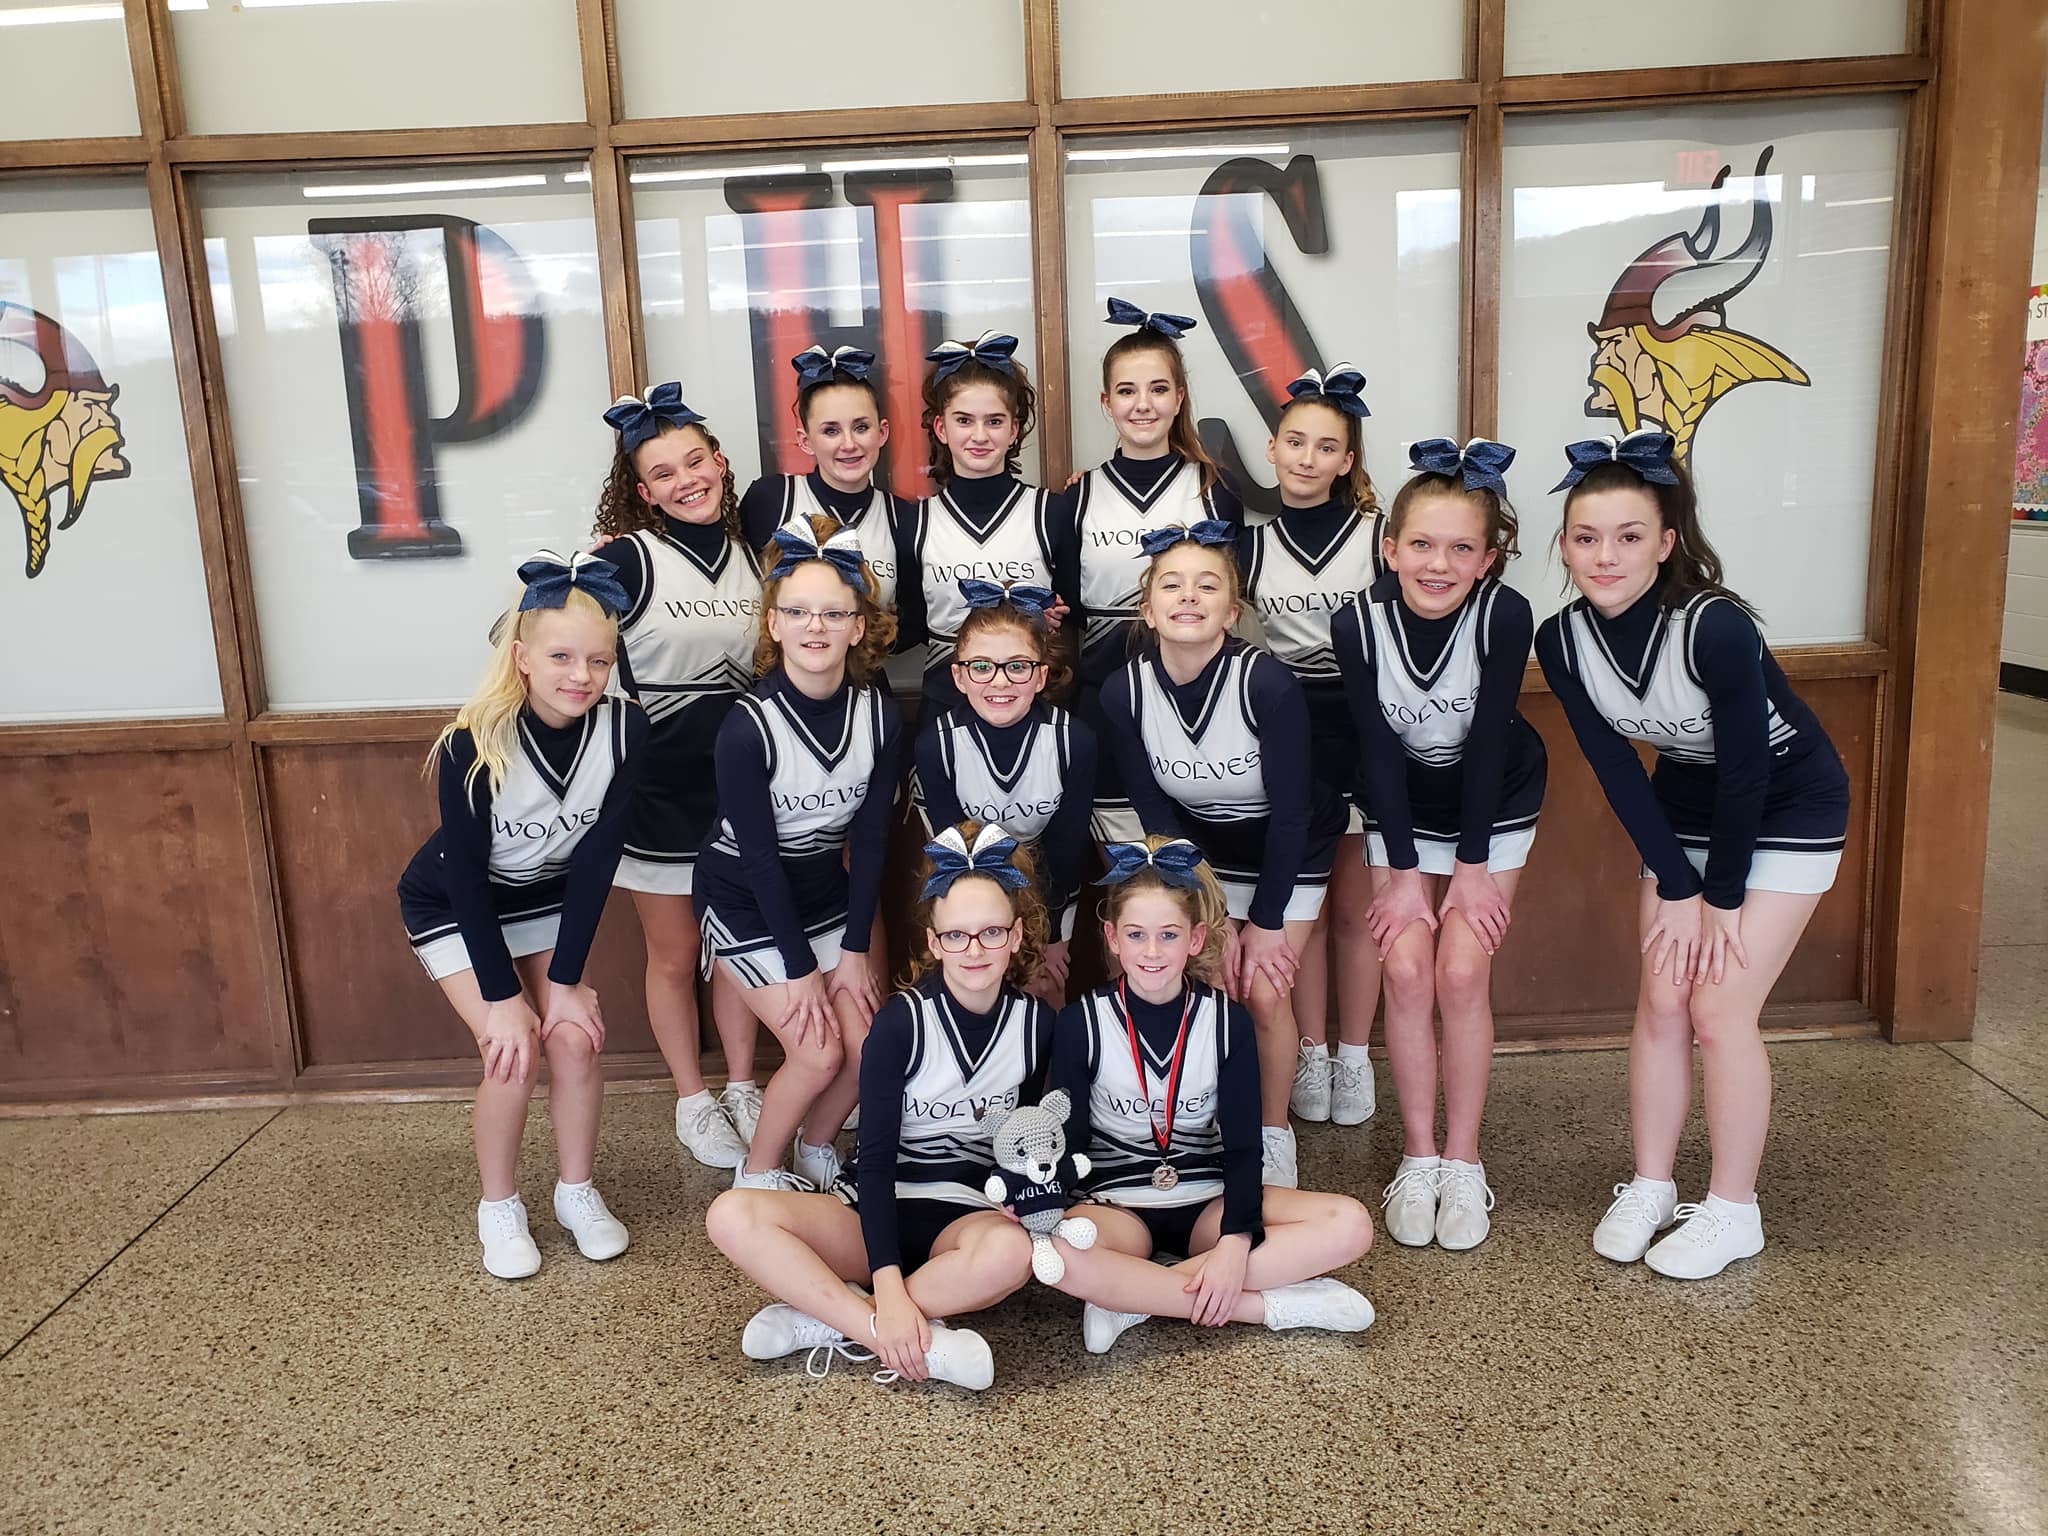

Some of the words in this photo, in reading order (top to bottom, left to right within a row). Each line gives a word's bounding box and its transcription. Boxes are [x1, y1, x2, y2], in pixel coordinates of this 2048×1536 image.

[931, 561, 1035, 583] WOLVES
[664, 599, 762, 619] WOLVES
[1262, 591, 1358, 615] WOLVE
[1149, 751, 1261, 780] WOLVES
[772, 782, 868, 811] WOLVE
[493, 808, 598, 839] WOLVE
[1158, 1168, 1173, 1183] 2
[1015, 1181, 1062, 1201] WOLVES
